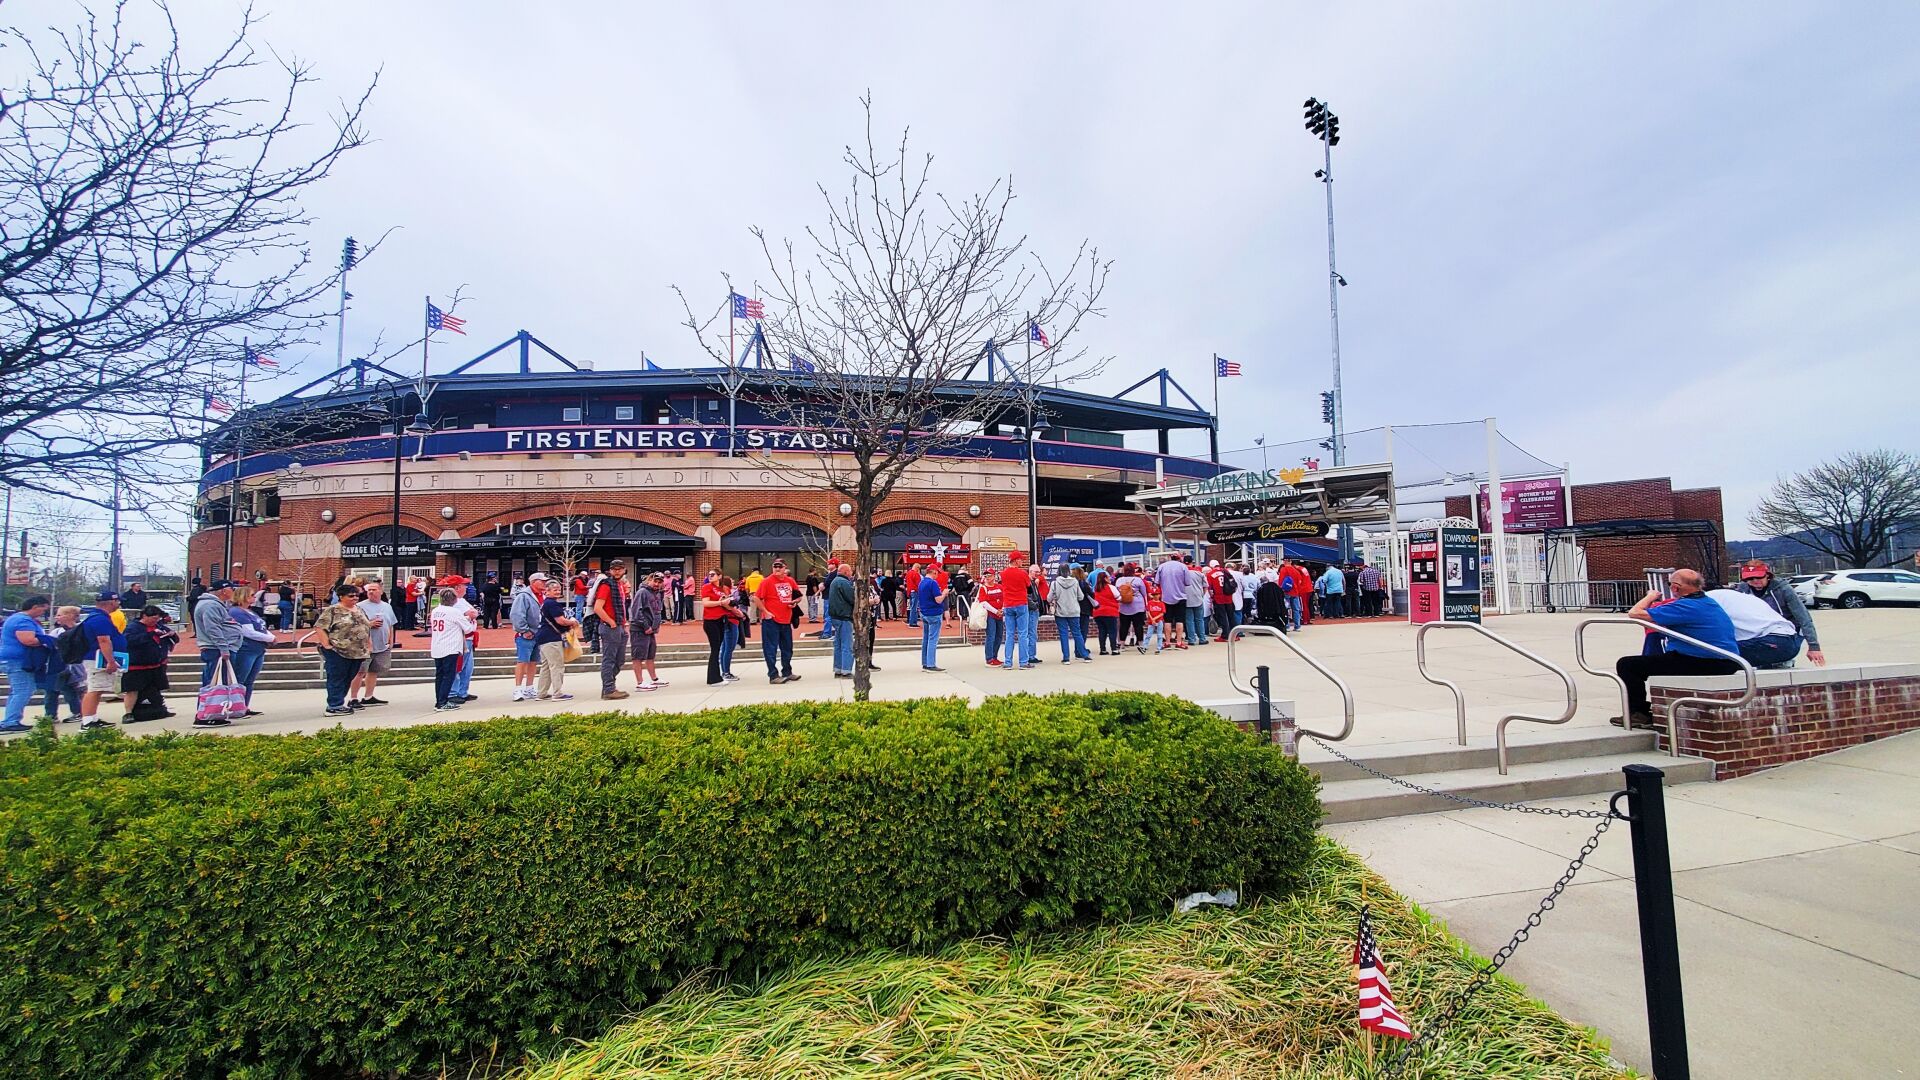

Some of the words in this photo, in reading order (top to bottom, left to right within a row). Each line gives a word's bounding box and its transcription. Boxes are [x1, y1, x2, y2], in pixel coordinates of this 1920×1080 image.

[506, 429, 717, 449] FIRSTENERGY
[747, 429, 878, 449] STADIU
[290, 479, 370, 494] HOME
[403, 475, 439, 488] OF
[475, 474, 545, 487] THE
[585, 471, 771, 485] READING
[1180, 468, 1280, 496] TOMPKINS
[1180, 498, 1212, 508] BANKING
[1219, 493, 1260, 504] INSURANCE
[1269, 488, 1300, 499] WEALTH
[1217, 508, 1260, 517] PLAZA
[494, 521, 602, 535] TICKETS
[1214, 530, 1246, 541] Welcome
[1258, 520, 1319, 538] Baseballtown
[1443, 533, 1471, 544] TOMPKINS
[342, 545, 368, 554] SAVAGE
[370, 545, 378, 554] 61
[1444, 604, 1473, 614] TOMPKINS
[432, 619, 445, 632] 26
